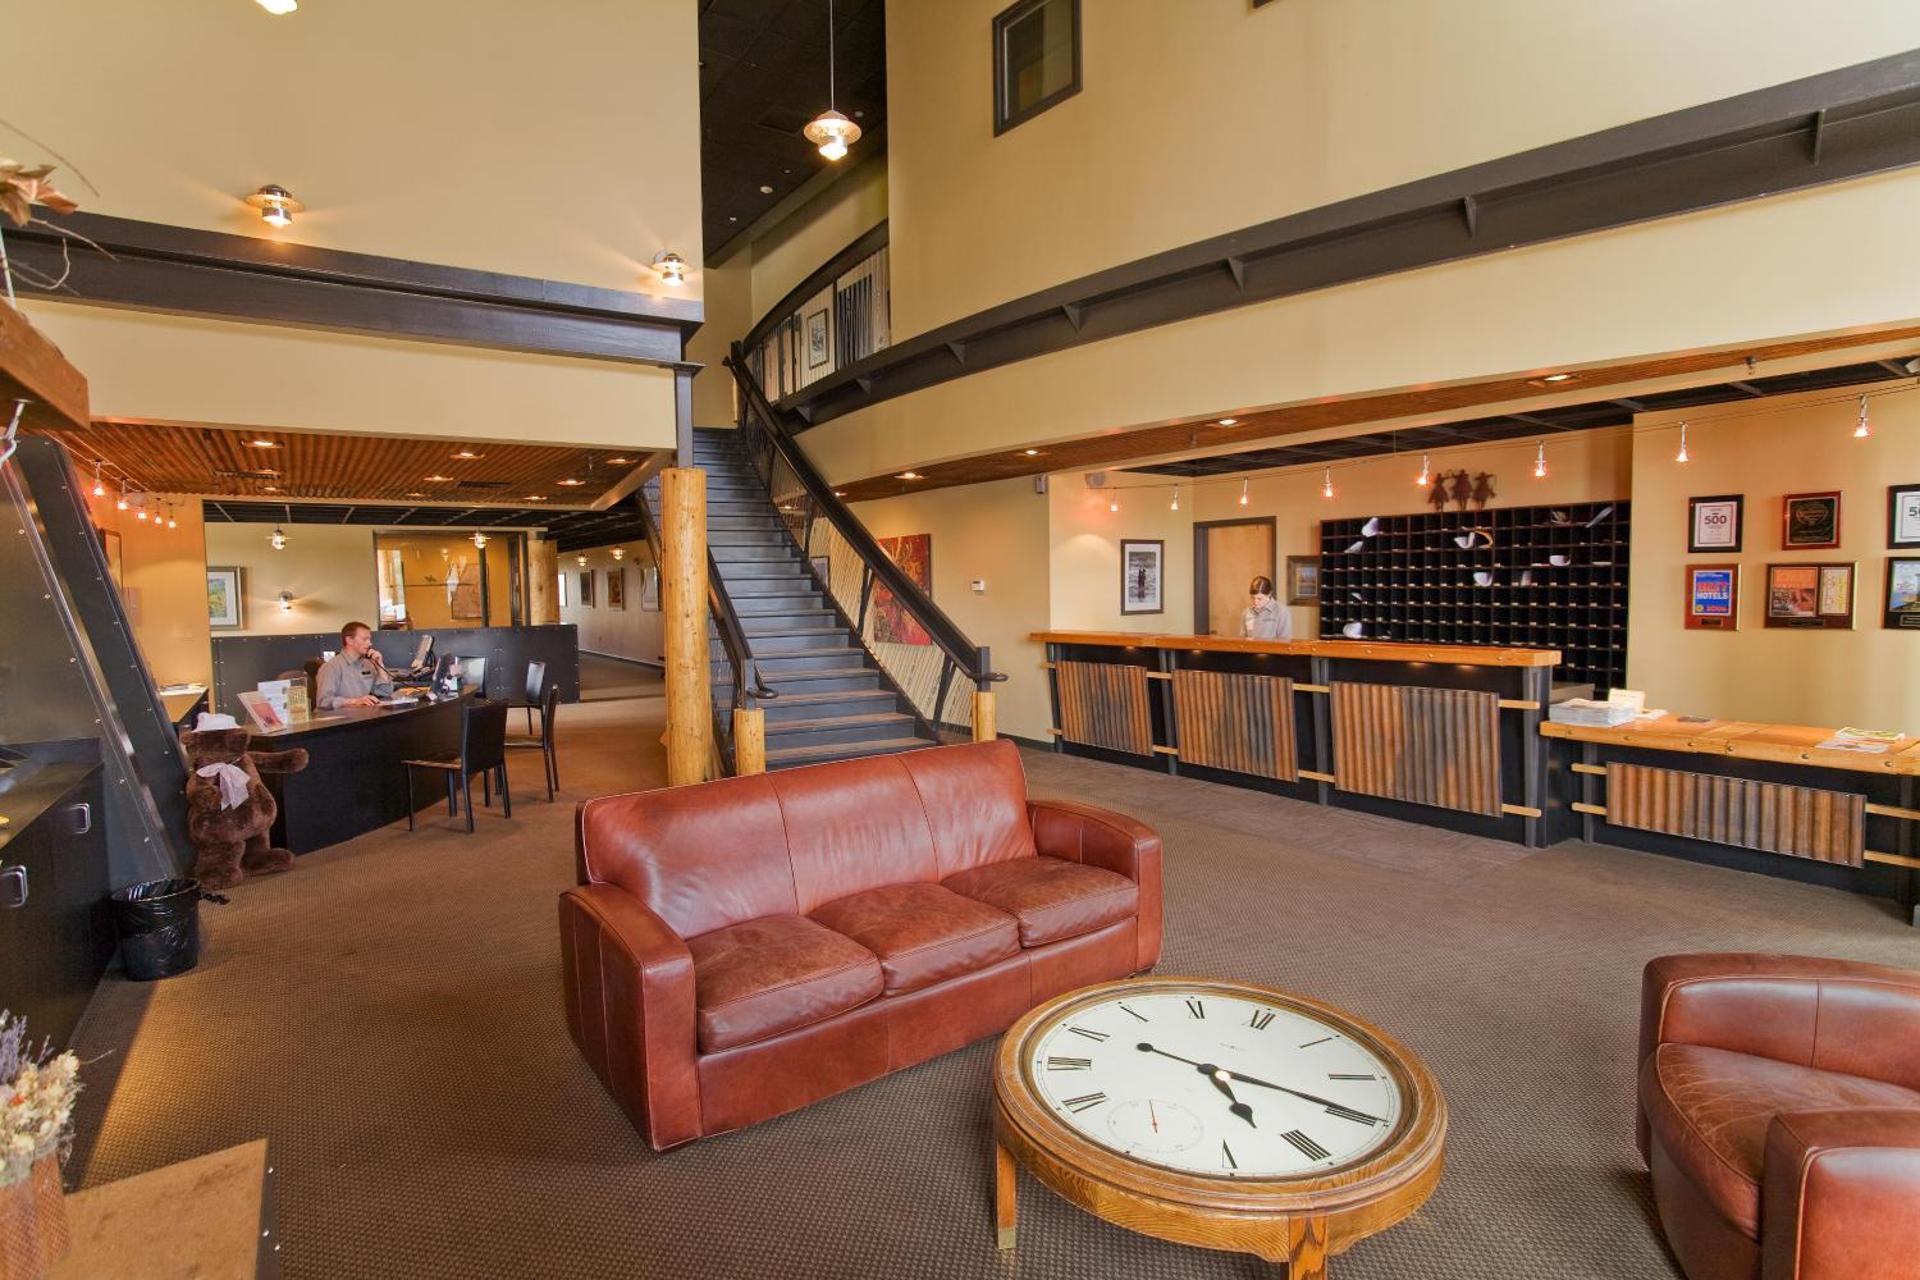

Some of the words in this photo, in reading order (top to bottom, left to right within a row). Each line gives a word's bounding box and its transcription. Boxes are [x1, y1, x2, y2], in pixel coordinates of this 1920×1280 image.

[1704, 515, 1727, 525] 500
[1241, 1009, 1276, 1031] XII
[1328, 1073, 1377, 1081] II
[1222, 1139, 1238, 1169] V
[1279, 1129, 1332, 1161] IIII
